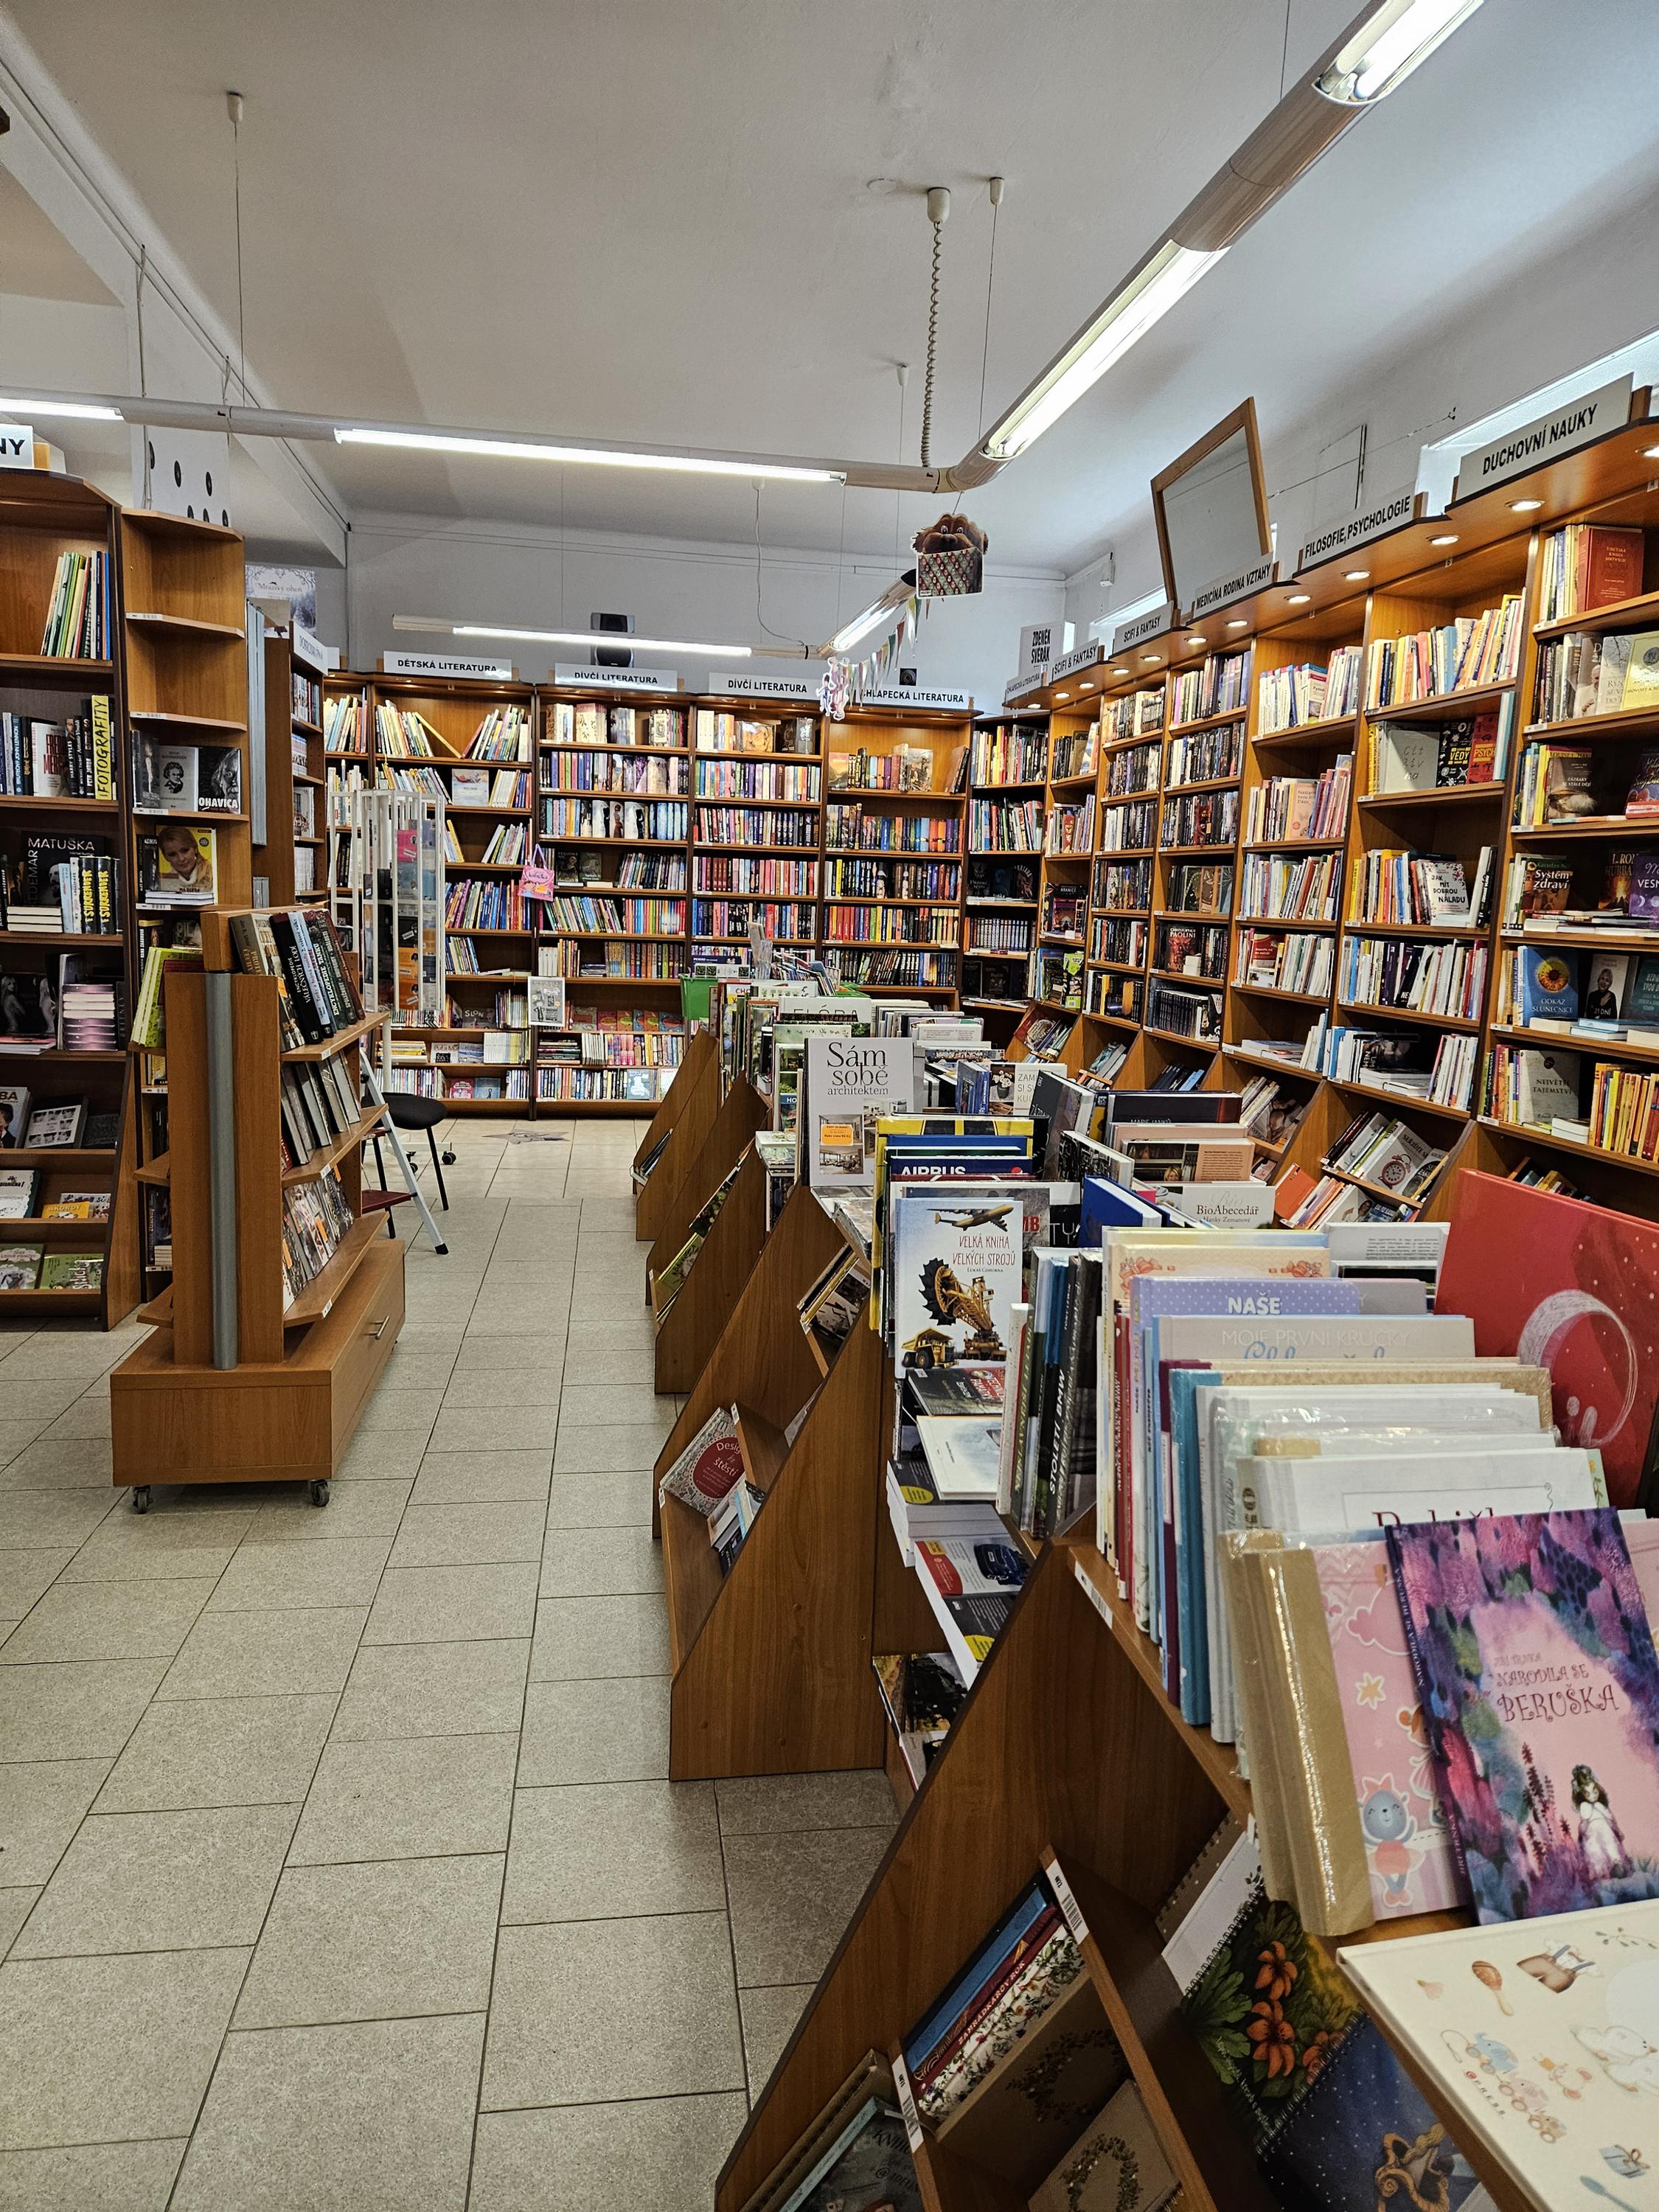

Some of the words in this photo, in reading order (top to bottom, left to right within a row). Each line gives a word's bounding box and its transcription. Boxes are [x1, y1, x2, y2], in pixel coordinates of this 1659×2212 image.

[1483, 424, 1547, 476] DUCHOVNÍ
[1548, 404, 1598, 444] NAUKY
[1305, 526, 1346, 560] FILOSOFIE,
[1347, 495, 1411, 540] PSYCHOLOGIE
[1196, 586, 1222, 611] MEDICÍNA
[1223, 575, 1245, 596] RODINA
[1245, 563, 1271, 588] VZTAHY
[1032, 627, 1051, 646] ZDENĚK
[1124, 629, 1136, 643] SCIFI
[1135, 627, 1140, 637] &
[1140, 615, 1161, 636] FANTASY
[397, 659, 436, 669] DĚTSKÁ
[439, 662, 497, 672] LITERATURA
[1054, 660, 1068, 675] SCIFI
[1068, 658, 1072, 668] &
[1073, 645, 1097, 665] FANTASY
[574, 671, 599, 681] DÍVČÍ
[602, 673, 658, 684] LITERATURA
[728, 678, 751, 689] DÍVČÍ
[754, 681, 807, 693] LITERATURA
[913, 692, 964, 703] LITERATURA
[1450, 750, 1470, 761] VĚDY
[28, 837, 95, 851] MATUŠKA
[1535, 869, 1570, 880] Systém
[1433, 887, 1458, 895] DOBROU
[1440, 880, 1450, 888] MÍT
[1533, 879, 1569, 890] zdraví
[1438, 893, 1466, 903] NÁLADU
[321, 965, 339, 1015] ENCYKLOPEDIE
[465, 1009, 484, 1018] SLON
[1531, 1005, 1573, 1014] SLUNEČNICE
[827, 1042, 888, 1068] Sám
[832, 1062, 888, 1087] sobě
[1018, 1073, 1036, 1082] ZAM
[1535, 1077, 1570, 1087] NEJVĚTŠÍ
[827, 1085, 888, 1096] architektem
[1532, 1085, 1573, 1095] TAJEMSTVÍ
[1197, 1203, 1259, 1216] BioAbecedář
[1203, 1216, 1221, 1225] Hanky
[1222, 1216, 1251, 1224] Zemanové
[959, 1233, 983, 1249] VELKÁ
[986, 1236, 1010, 1249] KNIHA
[953, 1250, 985, 1265] VELKÝCH
[987, 1251, 1016, 1266] STROJŮ
[1228, 1293, 1281, 1315] NAŠE
[1222, 1329, 1270, 1346] MOJE
[1276, 1326, 1332, 1346] PRVNÍ
[1049, 1420, 1062, 1495] STOLETÍ
[1056, 1370, 1066, 1416] BMW
[713, 1457, 740, 1477] štěstí
[1496, 1665, 1569, 1688] NARODILA
[1571, 1663, 1590, 1680] SE
[1496, 1683, 1620, 1723] BERUŠKA
[1009, 1961, 1026, 1980] ROK
